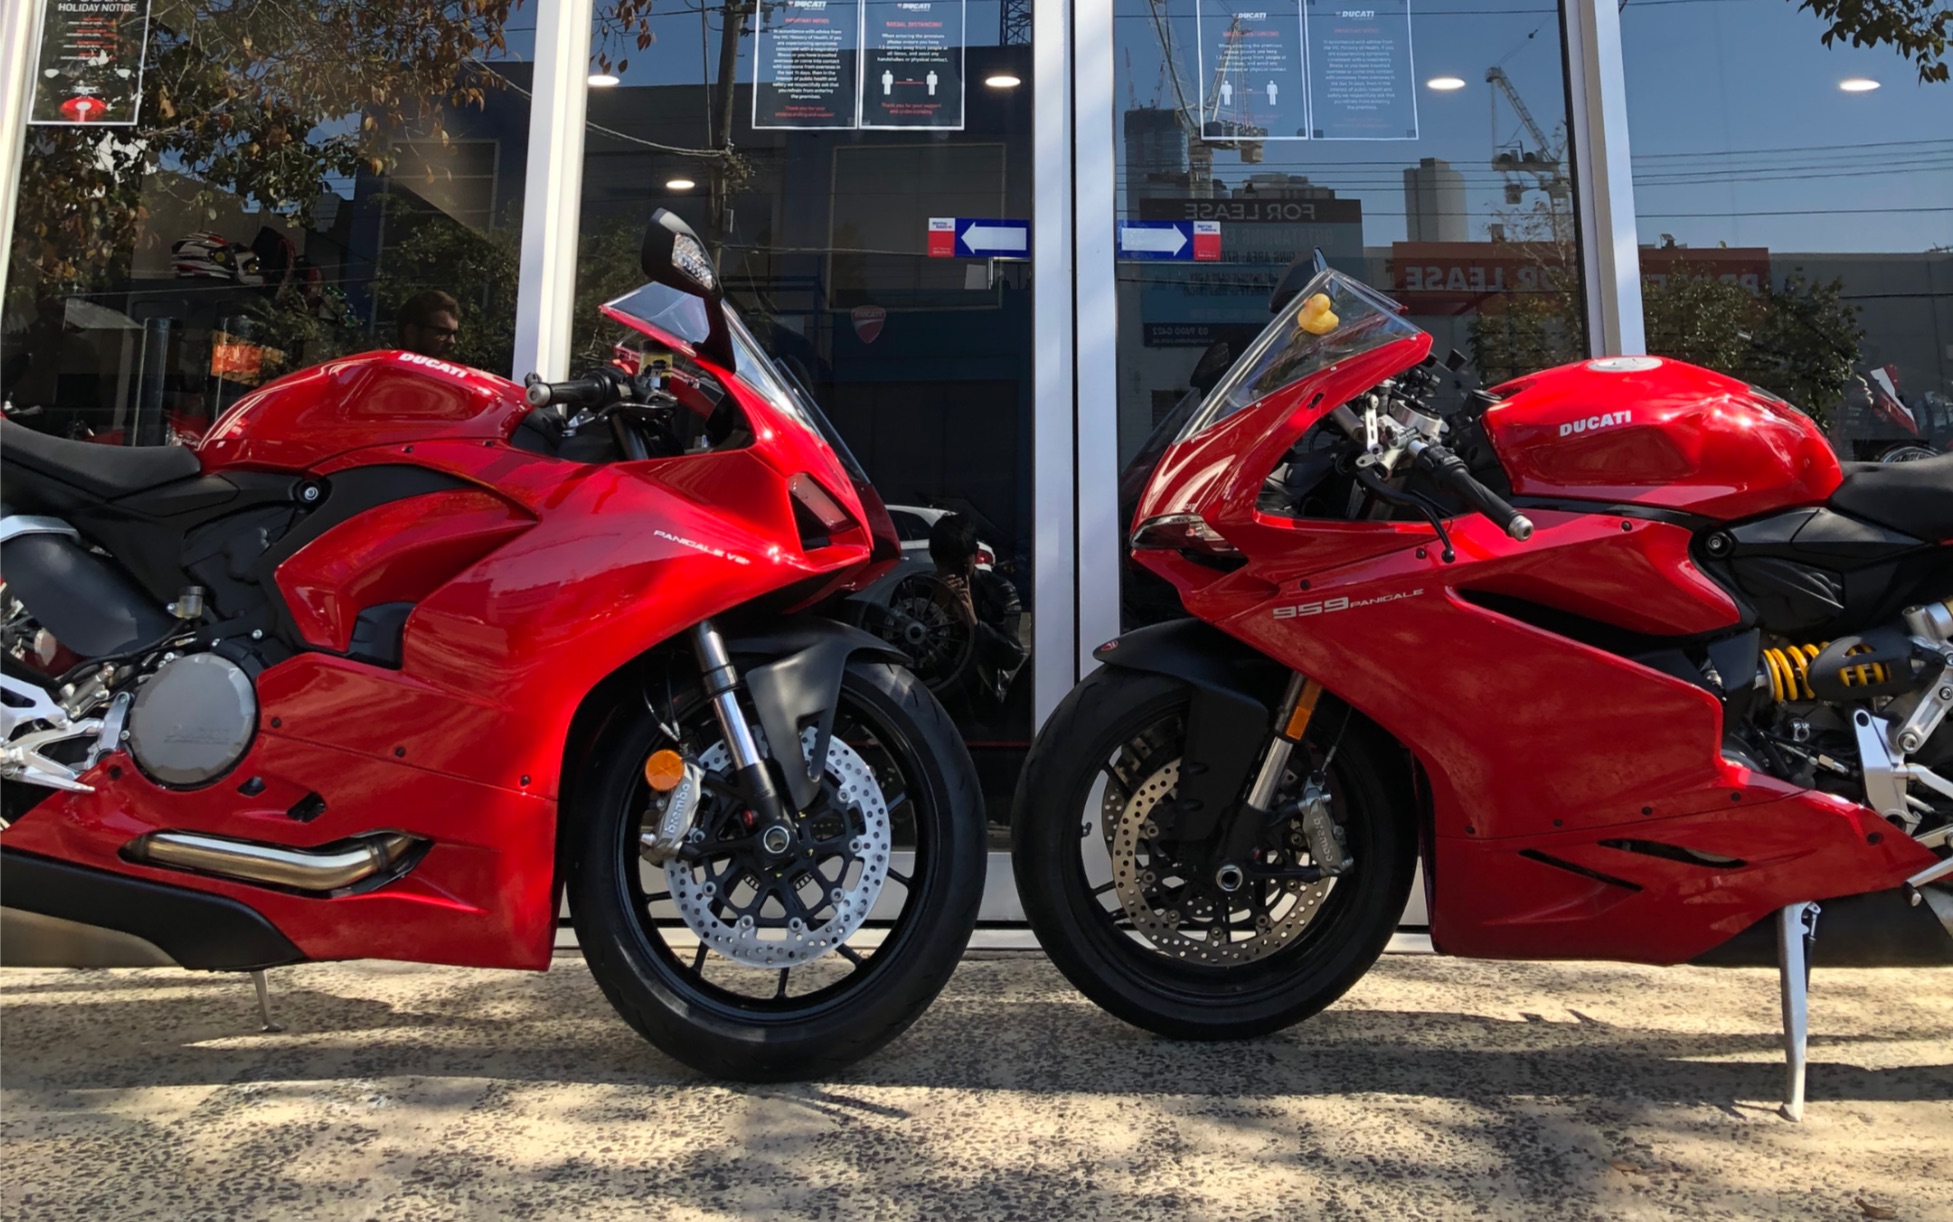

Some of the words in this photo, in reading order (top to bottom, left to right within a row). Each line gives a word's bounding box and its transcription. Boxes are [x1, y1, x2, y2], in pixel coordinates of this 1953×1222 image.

[58, 3, 100, 12] HOLIDAY
[101, 3, 137, 12] NOTICE
[398, 352, 468, 378] DUCATI
[1559, 410, 1632, 437] DUCATI
[653, 530, 725, 557] PANIGALE
[1273, 596, 1349, 619] 959
[1350, 588, 1424, 608] PANIGALE
[664, 783, 691, 834] brembo
[1313, 815, 1333, 862] brembo
